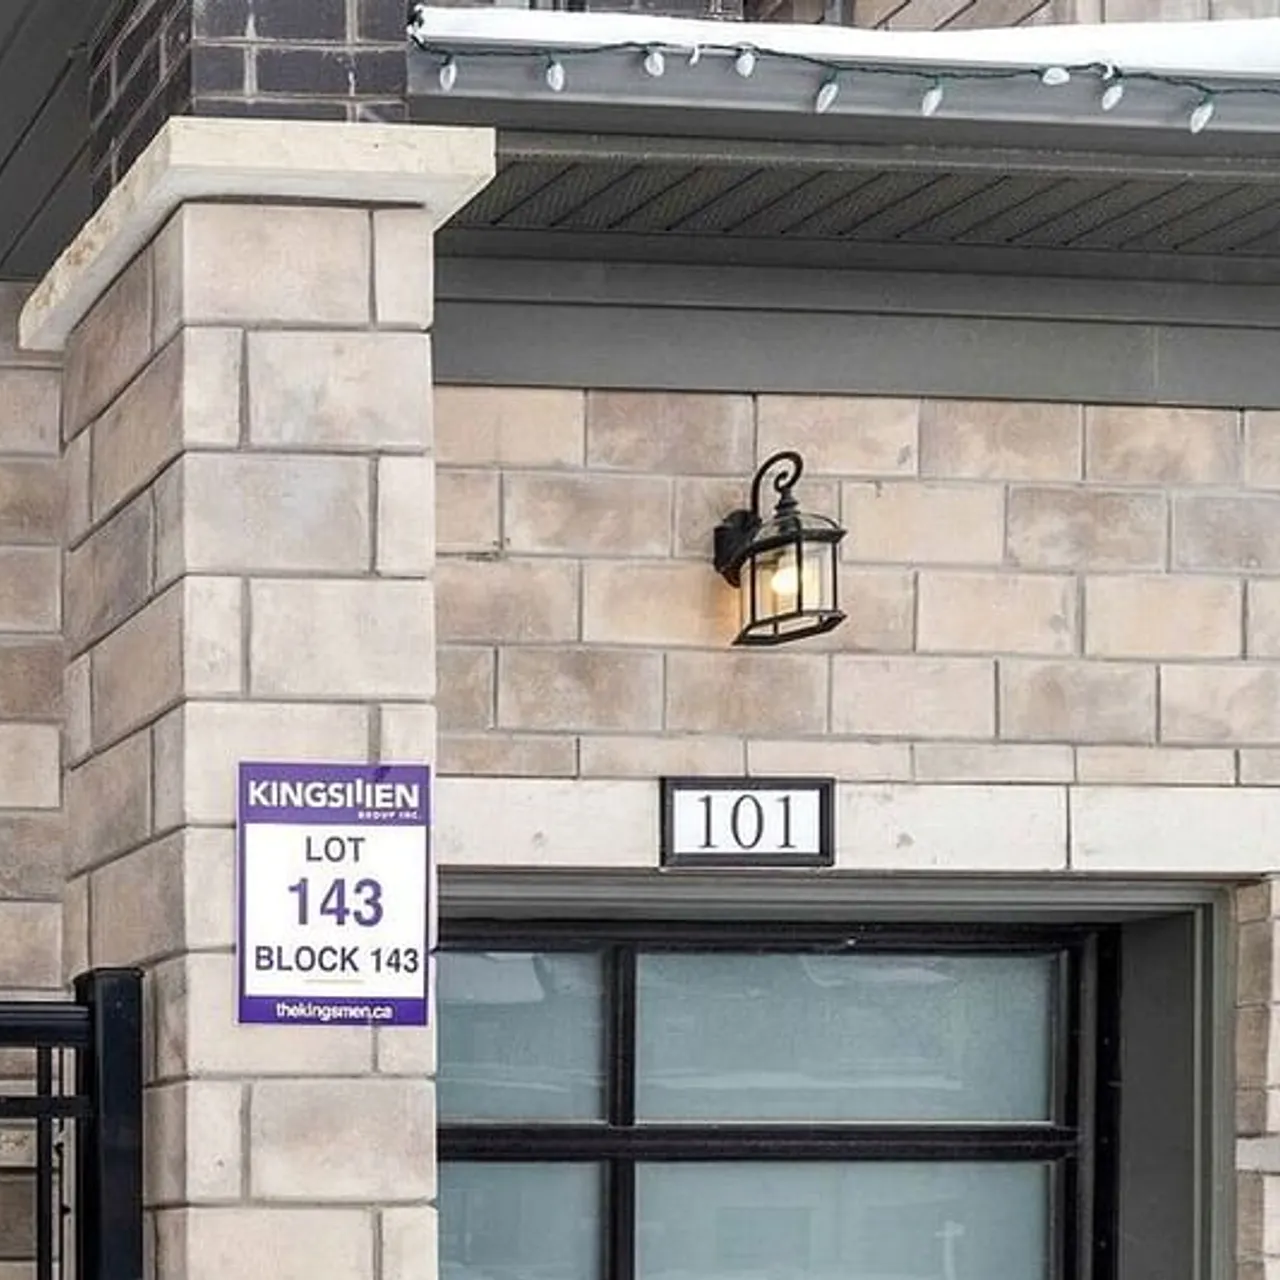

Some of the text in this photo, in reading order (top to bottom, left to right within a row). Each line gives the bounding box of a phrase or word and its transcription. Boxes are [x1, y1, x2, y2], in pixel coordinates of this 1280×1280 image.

[698, 794, 797, 850] 101
[305, 836, 365, 863] LOT
[288, 877, 384, 927] 143
[255, 945, 420, 973] BLOCK 143
[276, 1002, 393, 1021] thekingsmen.ca
